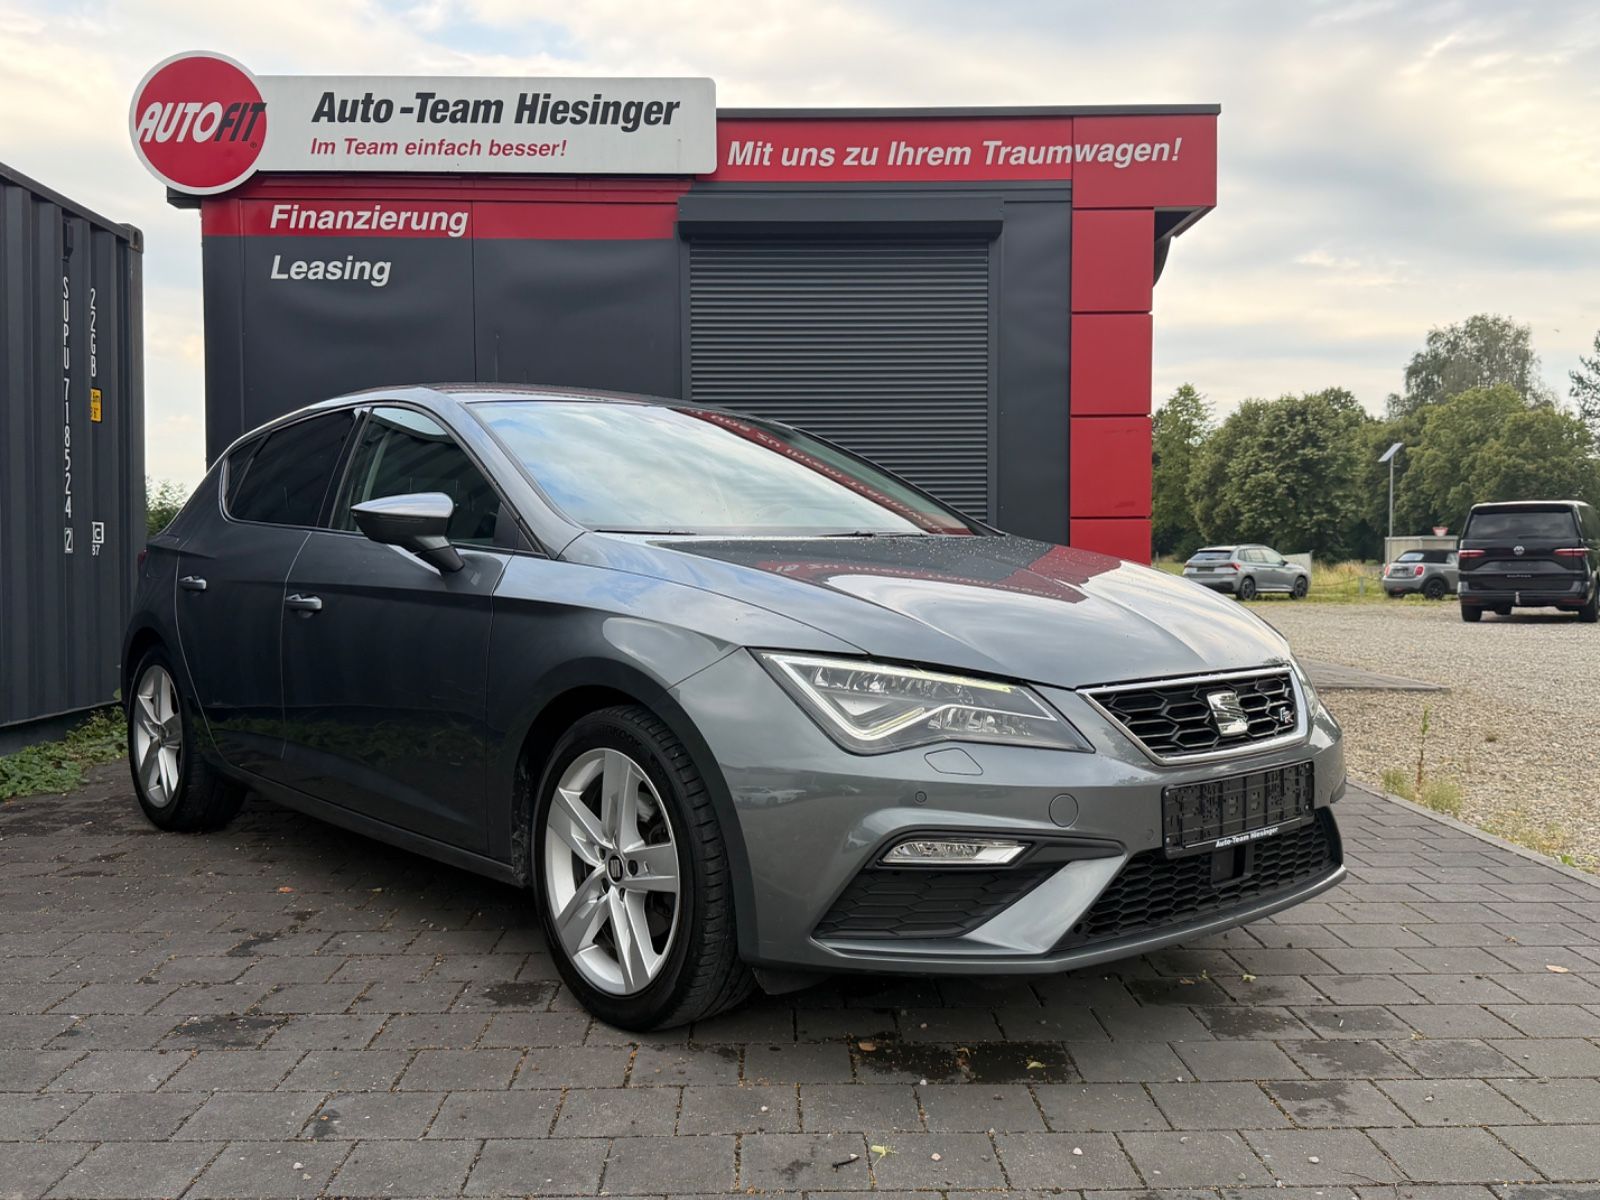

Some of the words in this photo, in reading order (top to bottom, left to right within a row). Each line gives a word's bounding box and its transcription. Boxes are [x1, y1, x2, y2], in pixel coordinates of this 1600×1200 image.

[138, 102, 267, 143] AUTOFIT
[514, 92, 680, 133] Hiesinger
[310, 137, 336, 154] Im
[344, 137, 399, 155] Team
[405, 137, 482, 157] einfach
[488, 139, 567, 157] besser!
[728, 140, 773, 166] Mit
[781, 147, 835, 167] uns
[843, 147, 879, 167] zu
[887, 141, 972, 166] Ihrem
[982, 137, 1183, 169] Traumwagen!
[270, 205, 469, 238] Finanzierung
[270, 254, 392, 287] Leasing
[63, 276, 71, 370] SUPU
[63, 377, 72, 519] 718524
